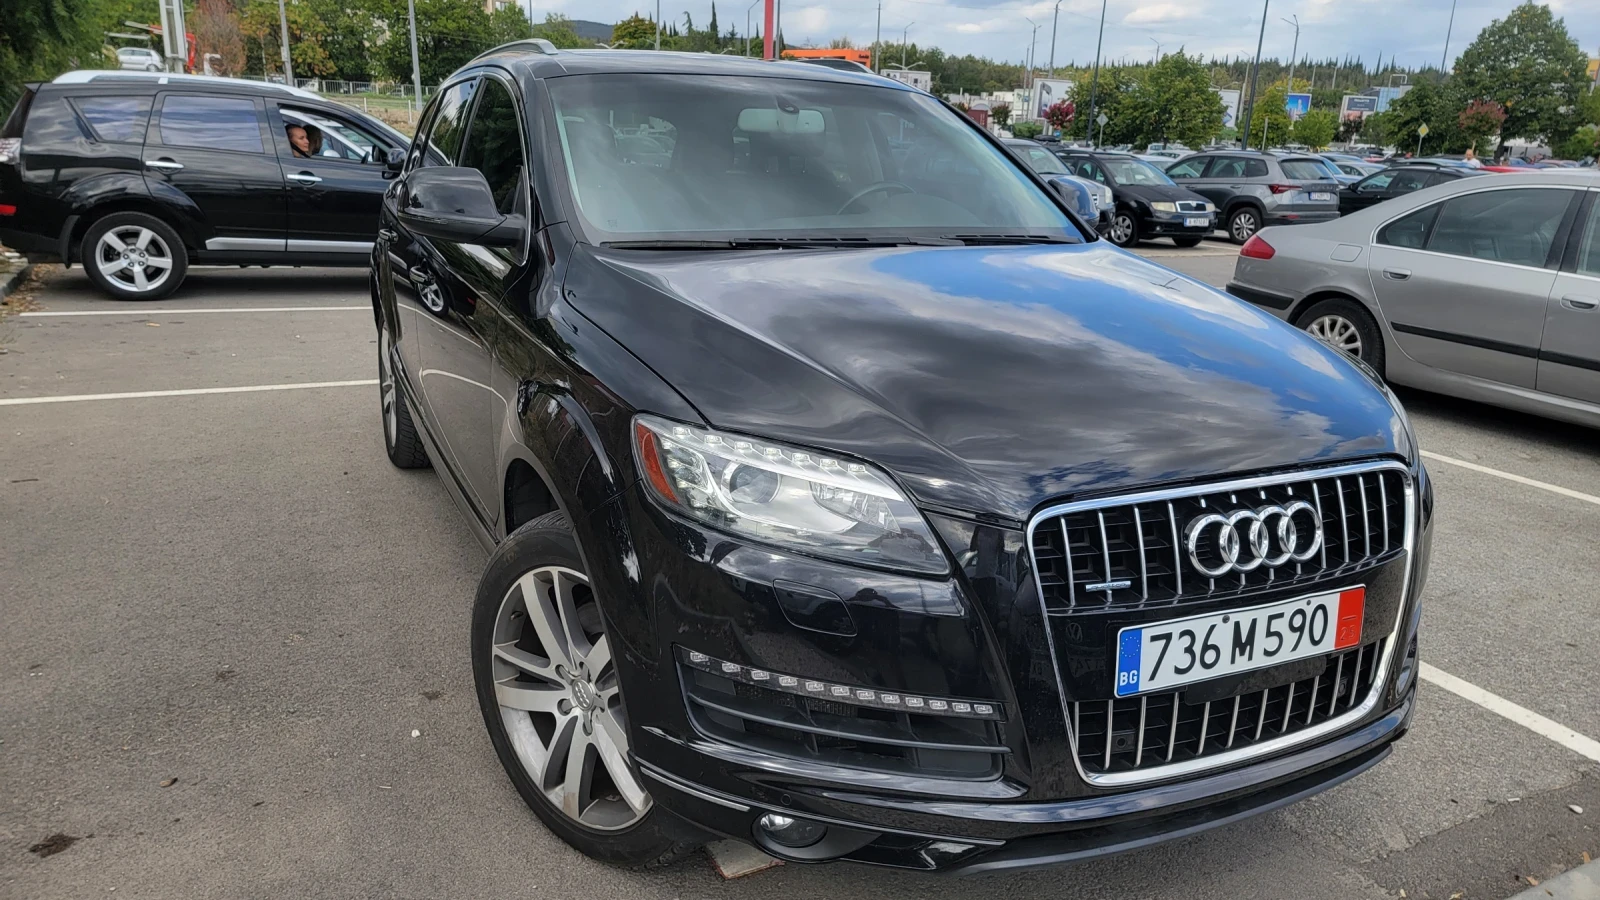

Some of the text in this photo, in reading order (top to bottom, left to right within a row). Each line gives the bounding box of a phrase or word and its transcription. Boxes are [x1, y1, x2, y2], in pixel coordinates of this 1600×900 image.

[1147, 602, 1329, 683] 736 M 590
[1119, 670, 1138, 687] BG
